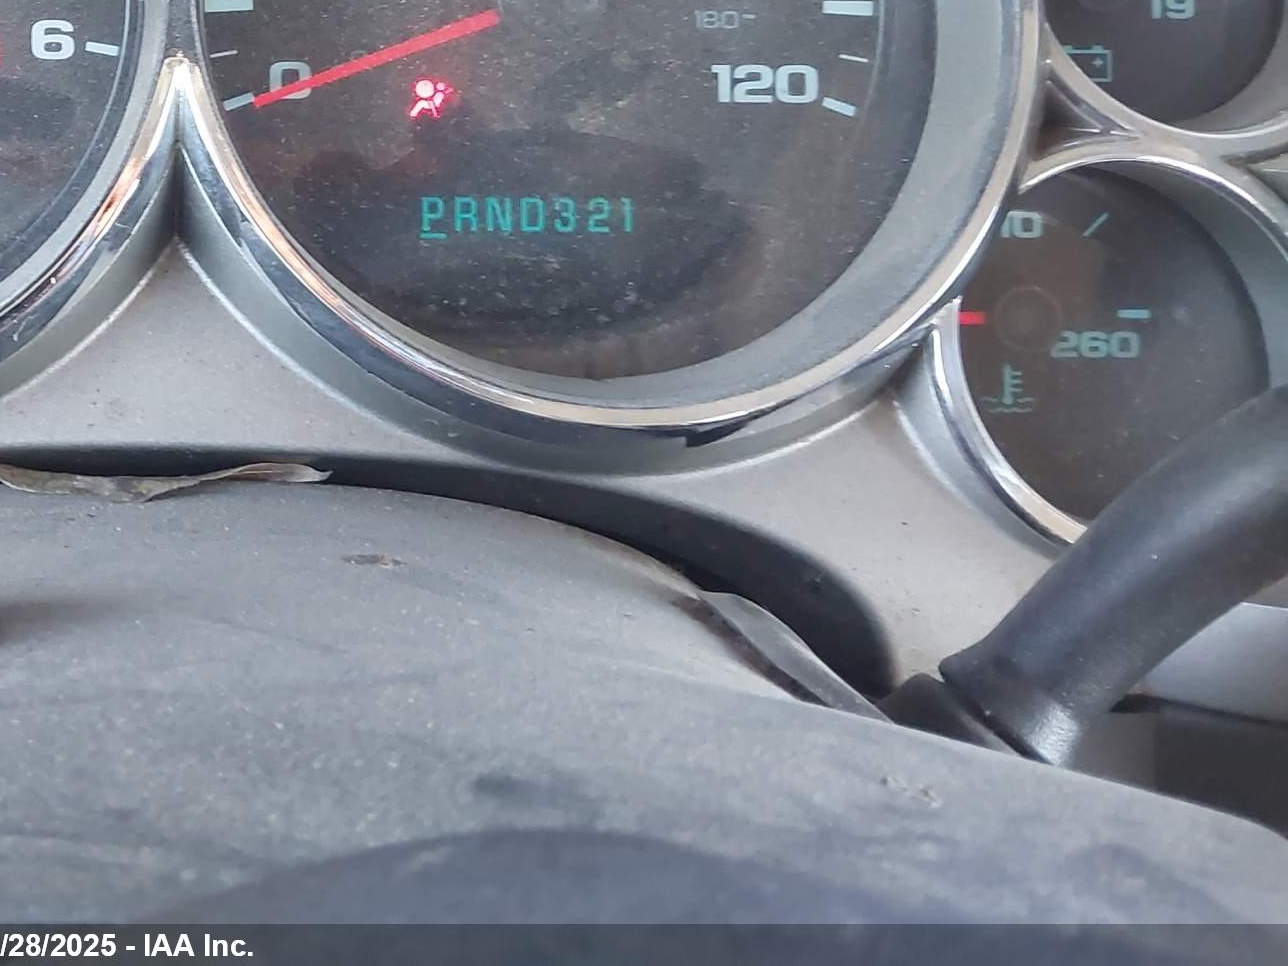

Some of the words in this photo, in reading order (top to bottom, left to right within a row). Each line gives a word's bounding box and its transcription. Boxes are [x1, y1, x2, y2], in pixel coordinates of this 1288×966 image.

[694, 9, 740, 29] 180
[30, 19, 76, 61] 6
[268, 61, 312, 100] 0
[711, 64, 819, 103] 120
[1050, 331, 1139, 359] 260
